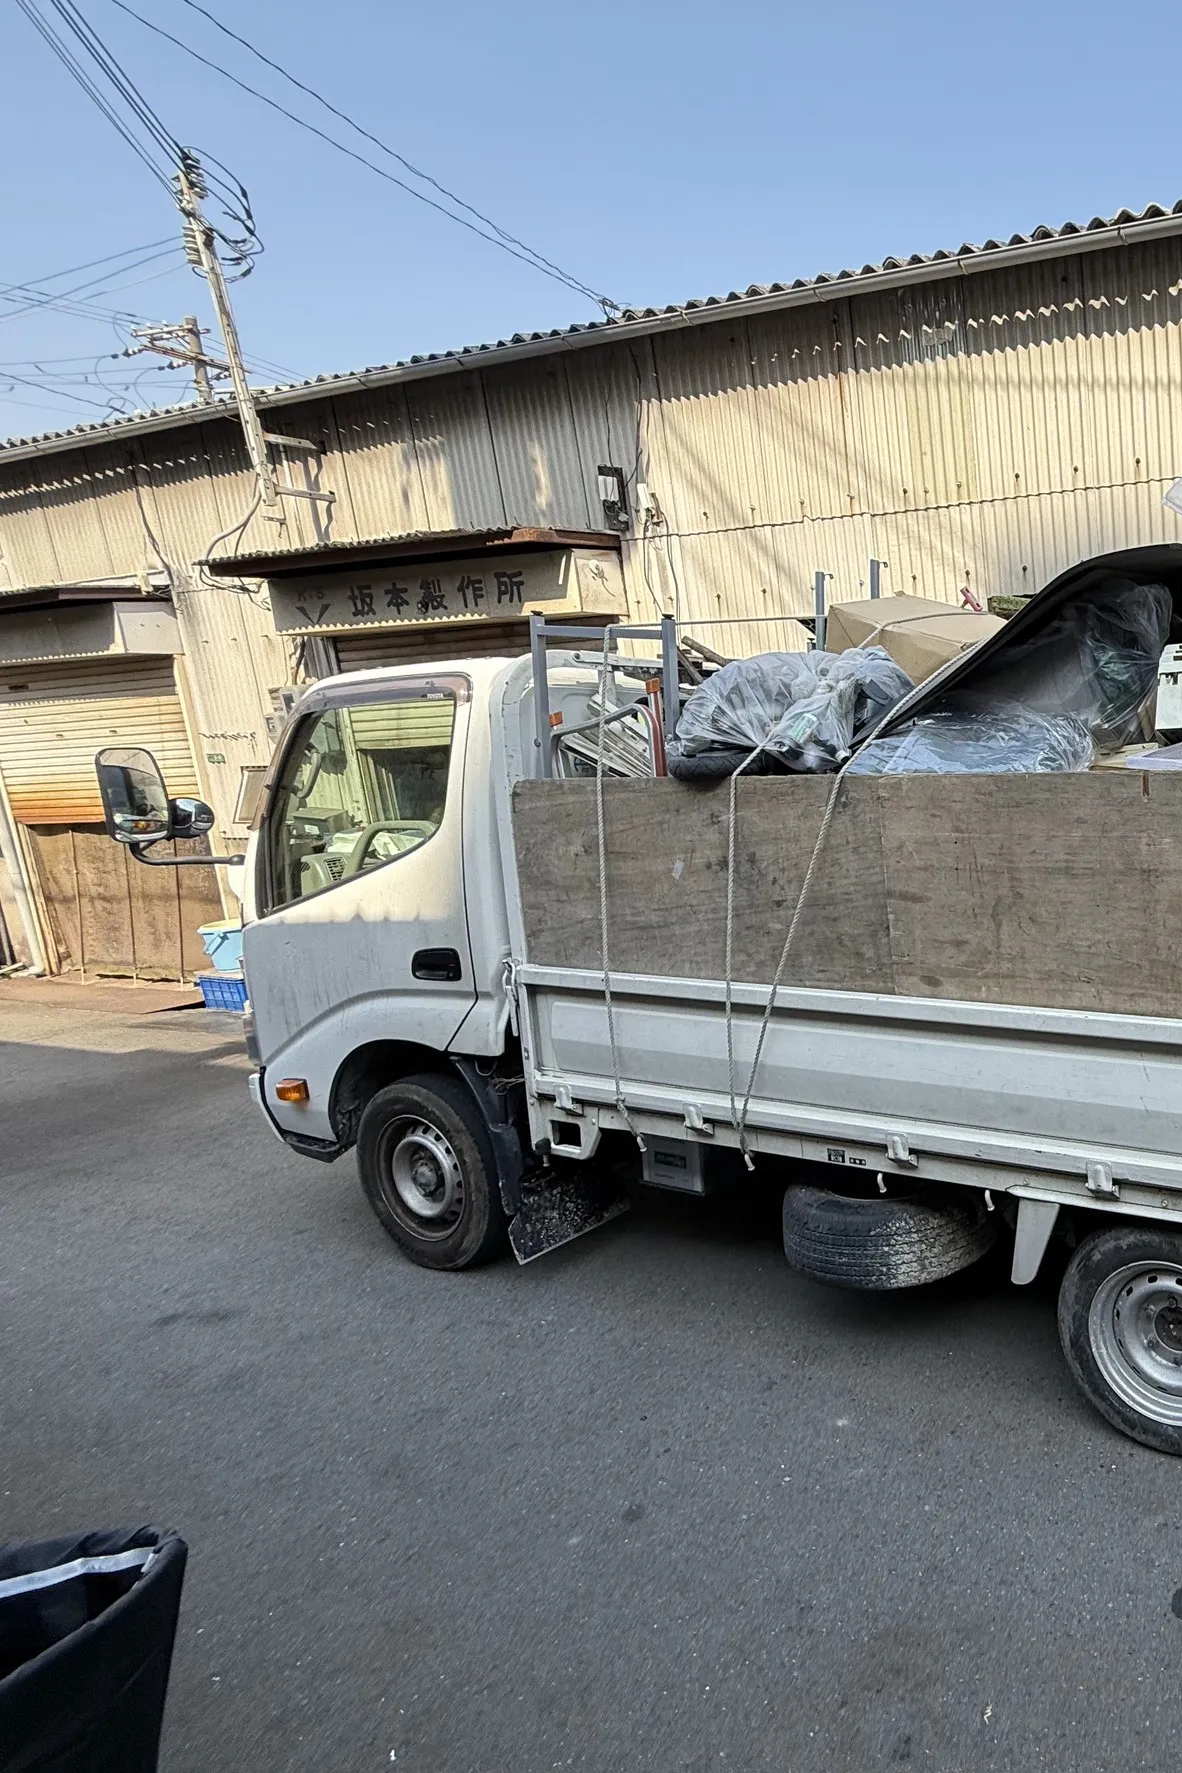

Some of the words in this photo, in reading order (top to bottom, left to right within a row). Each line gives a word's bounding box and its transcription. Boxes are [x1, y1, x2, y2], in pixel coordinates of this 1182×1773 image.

[347, 570, 525, 617] 坂本製作所
